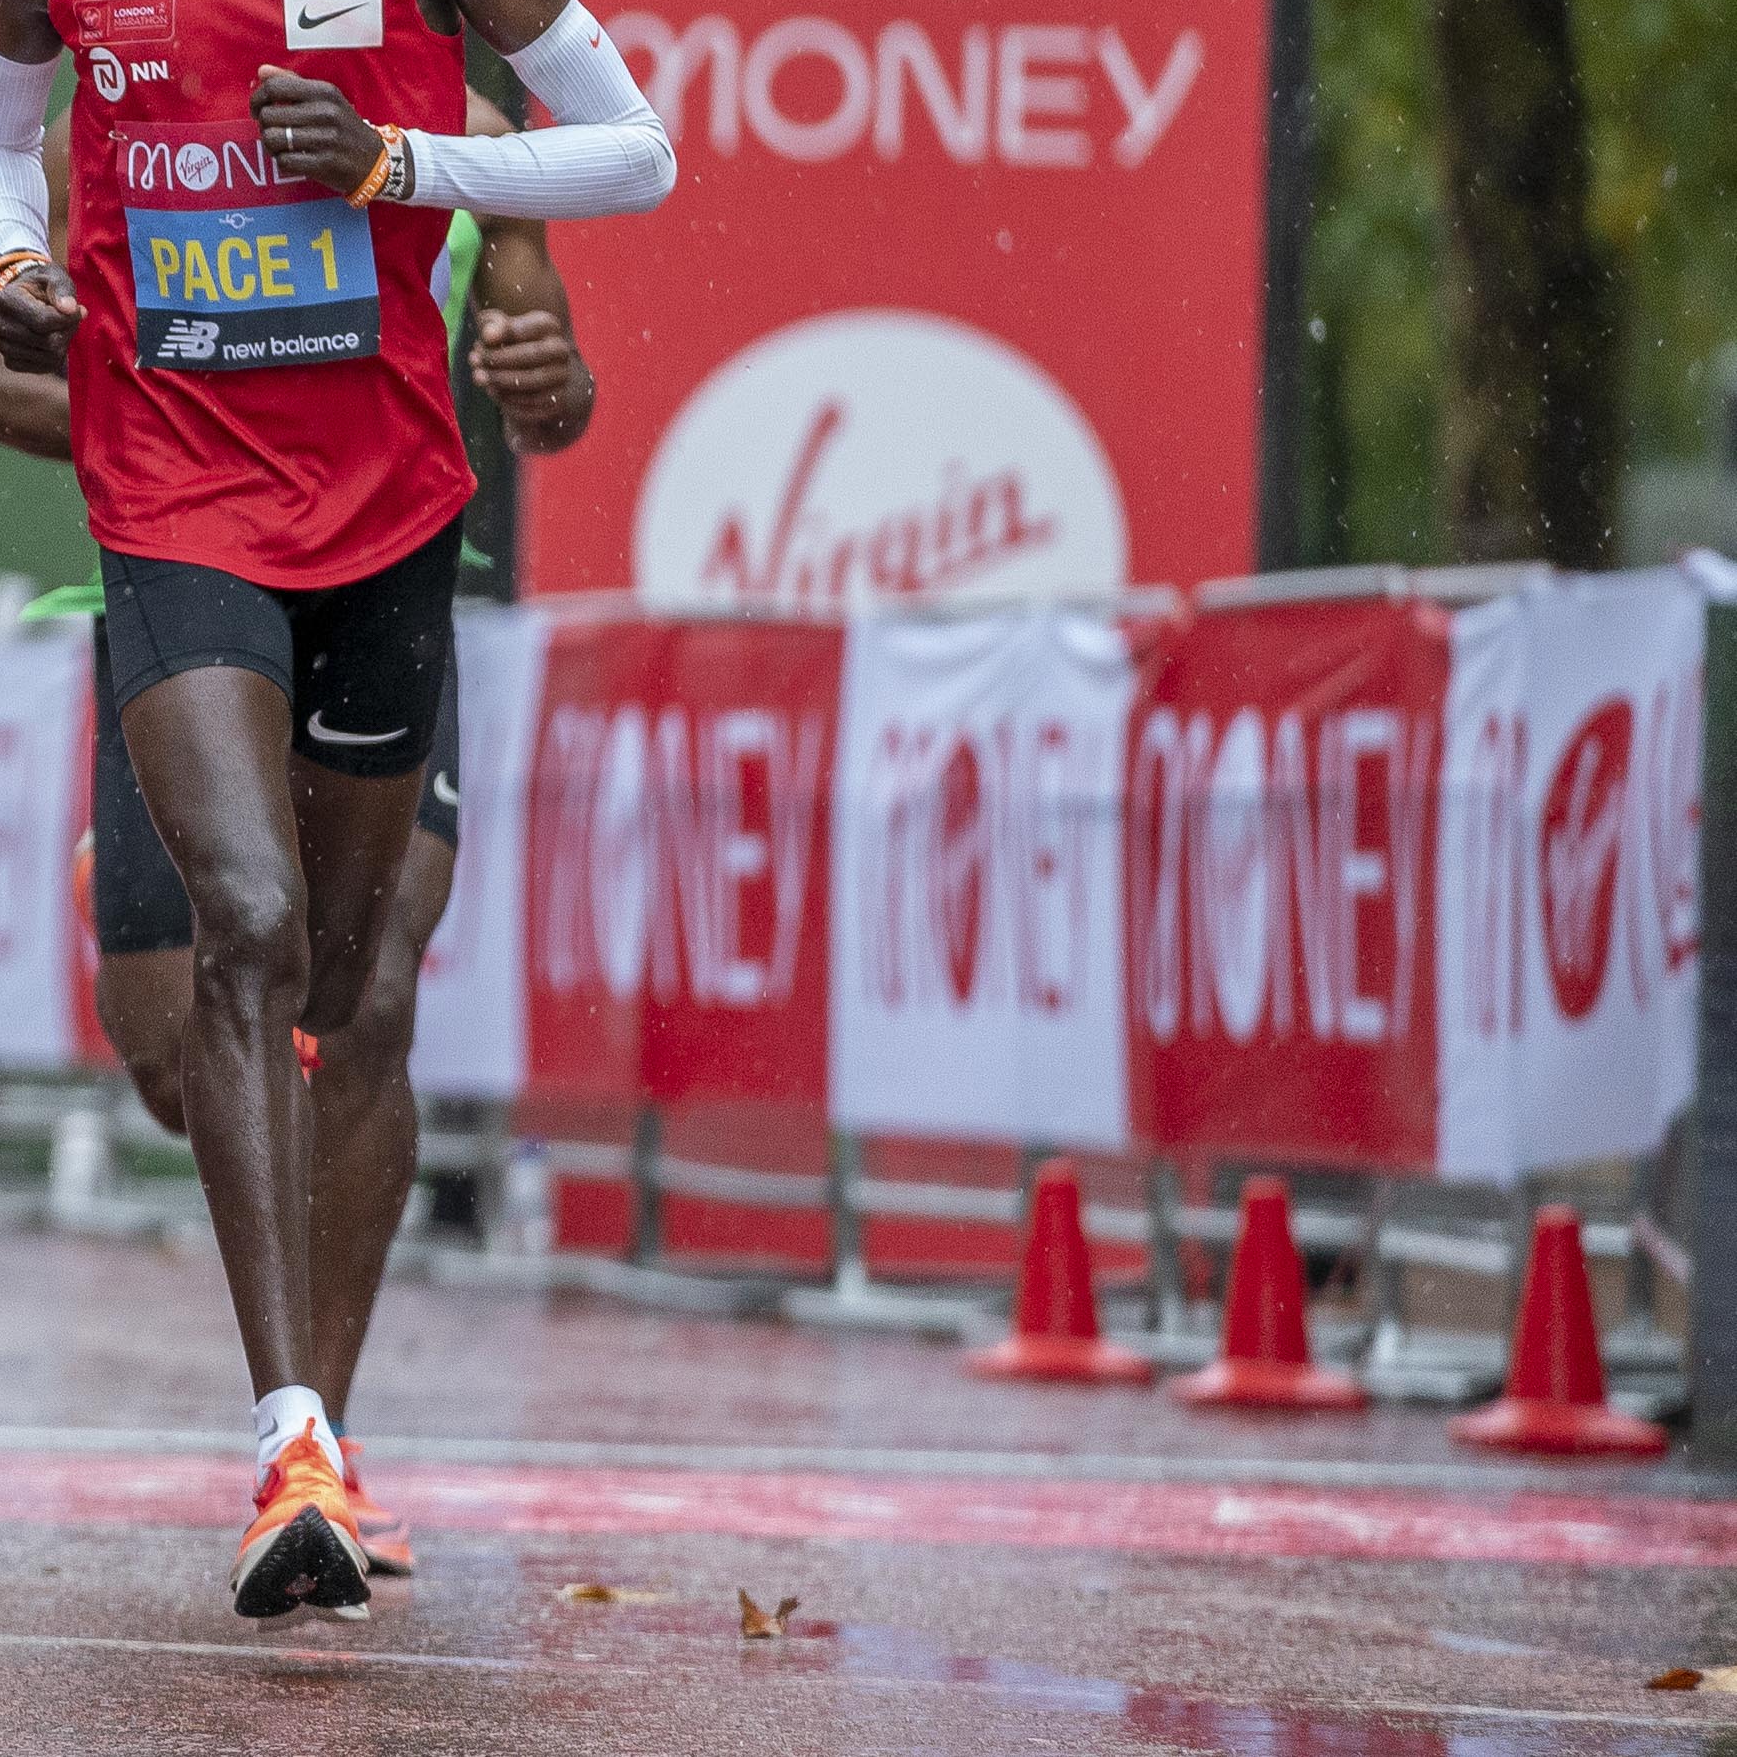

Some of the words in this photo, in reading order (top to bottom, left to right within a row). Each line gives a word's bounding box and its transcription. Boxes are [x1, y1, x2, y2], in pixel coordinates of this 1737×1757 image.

[113, 6, 155, 18] LONDON
[130, 60, 170, 82] NN
[606, 10, 1205, 171] MONEY
[178, 150, 214, 183] Virgin
[150, 234, 295, 302] PACE
[311, 228, 339, 291] 1
[223, 342, 266, 360] new
[270, 332, 359, 356] balance
